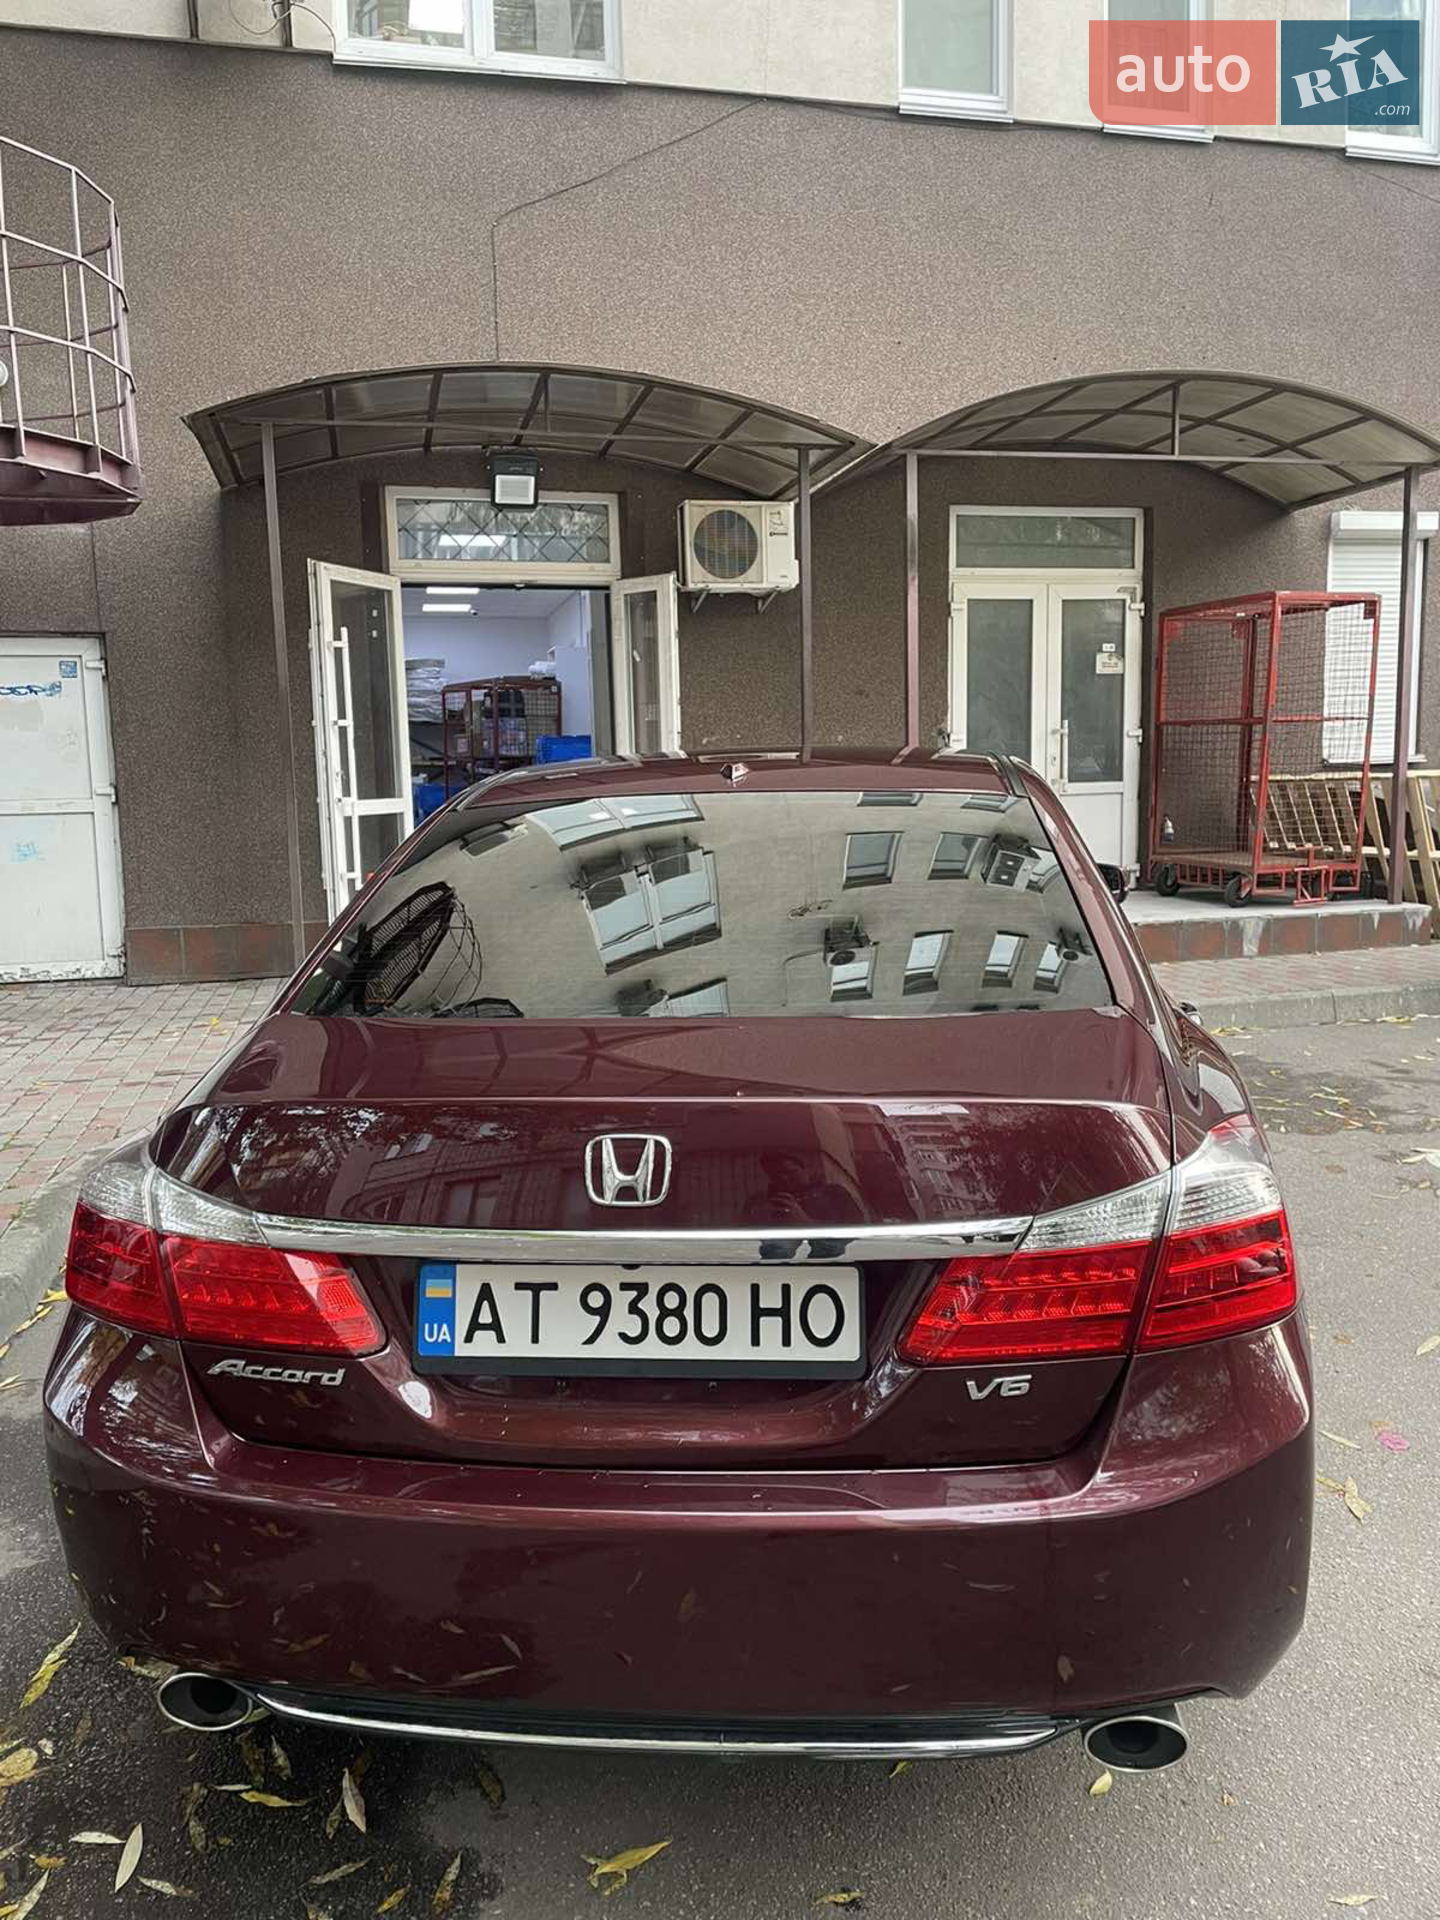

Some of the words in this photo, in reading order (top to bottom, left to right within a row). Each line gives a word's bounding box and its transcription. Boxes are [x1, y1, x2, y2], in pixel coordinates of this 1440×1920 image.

[463, 1282, 559, 1344] AT
[579, 1282, 728, 1347] 9380
[750, 1283, 846, 1348] HO
[423, 1323, 451, 1343] UA
[206, 1358, 346, 1387] Accord
[966, 1374, 1032, 1400] V6
